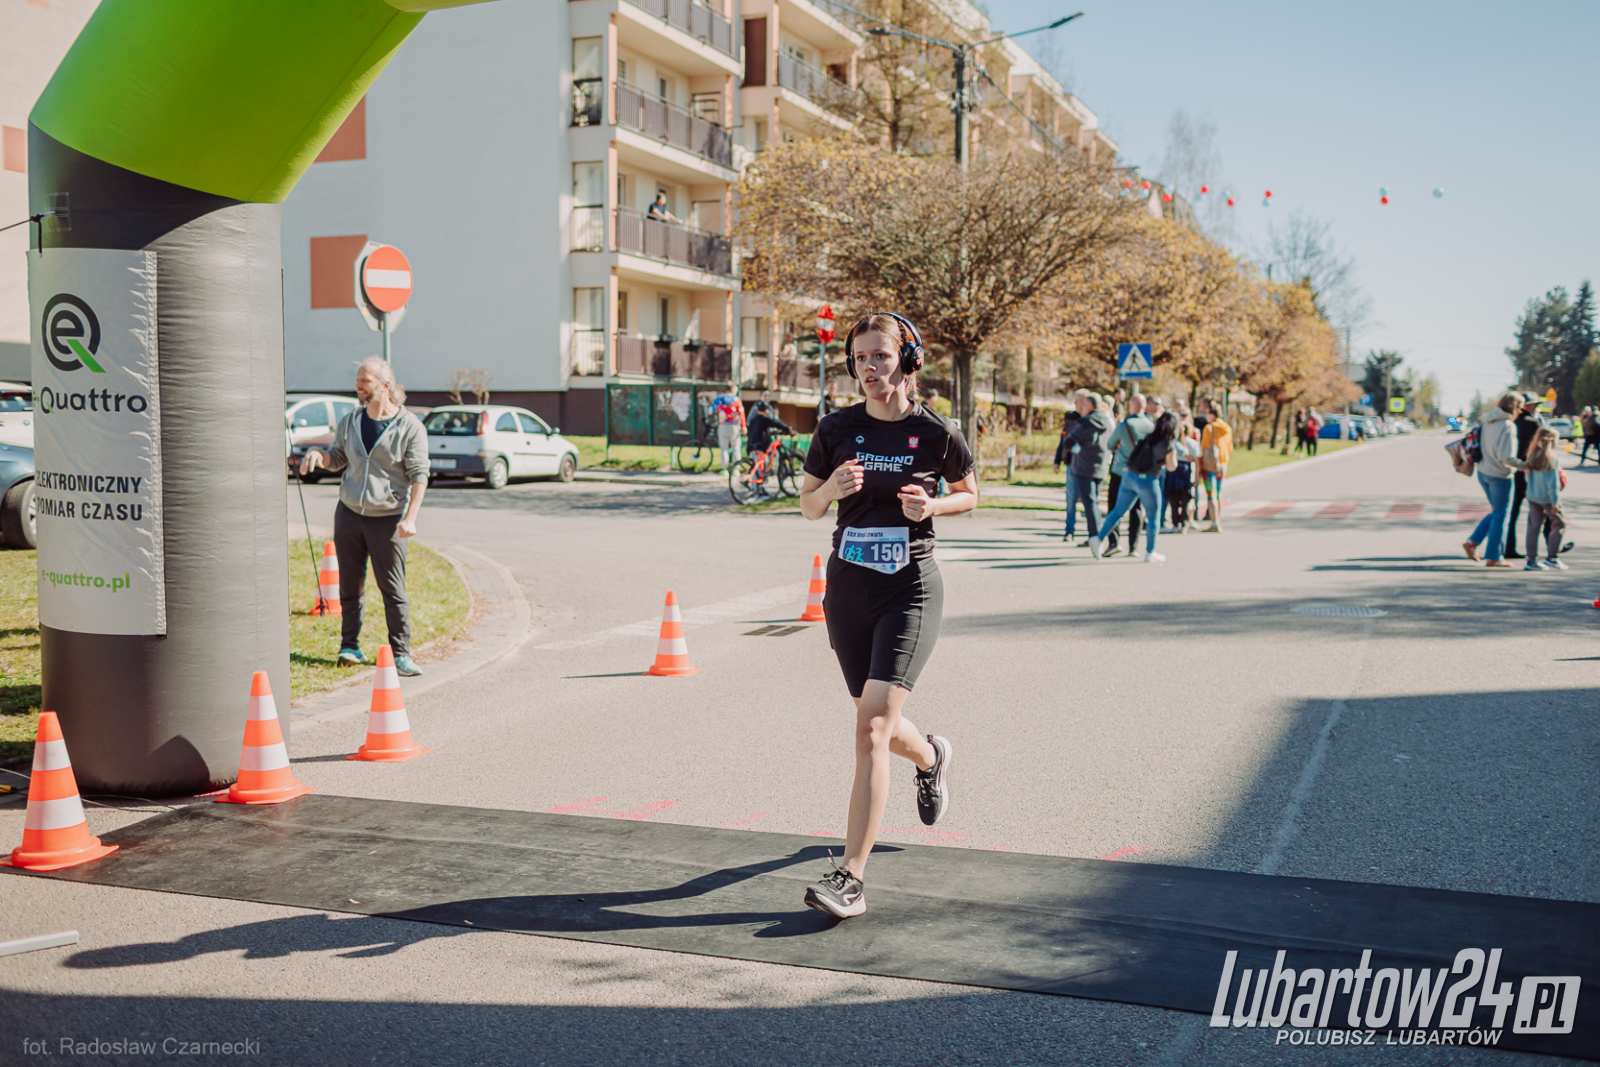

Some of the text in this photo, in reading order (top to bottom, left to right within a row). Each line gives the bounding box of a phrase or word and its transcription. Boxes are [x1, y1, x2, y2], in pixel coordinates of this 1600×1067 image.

[856, 451, 914, 466] GROUND
[864, 461, 903, 472] GAME
[81, 502, 143, 521] CZASU
[870, 543, 904, 562] 150
